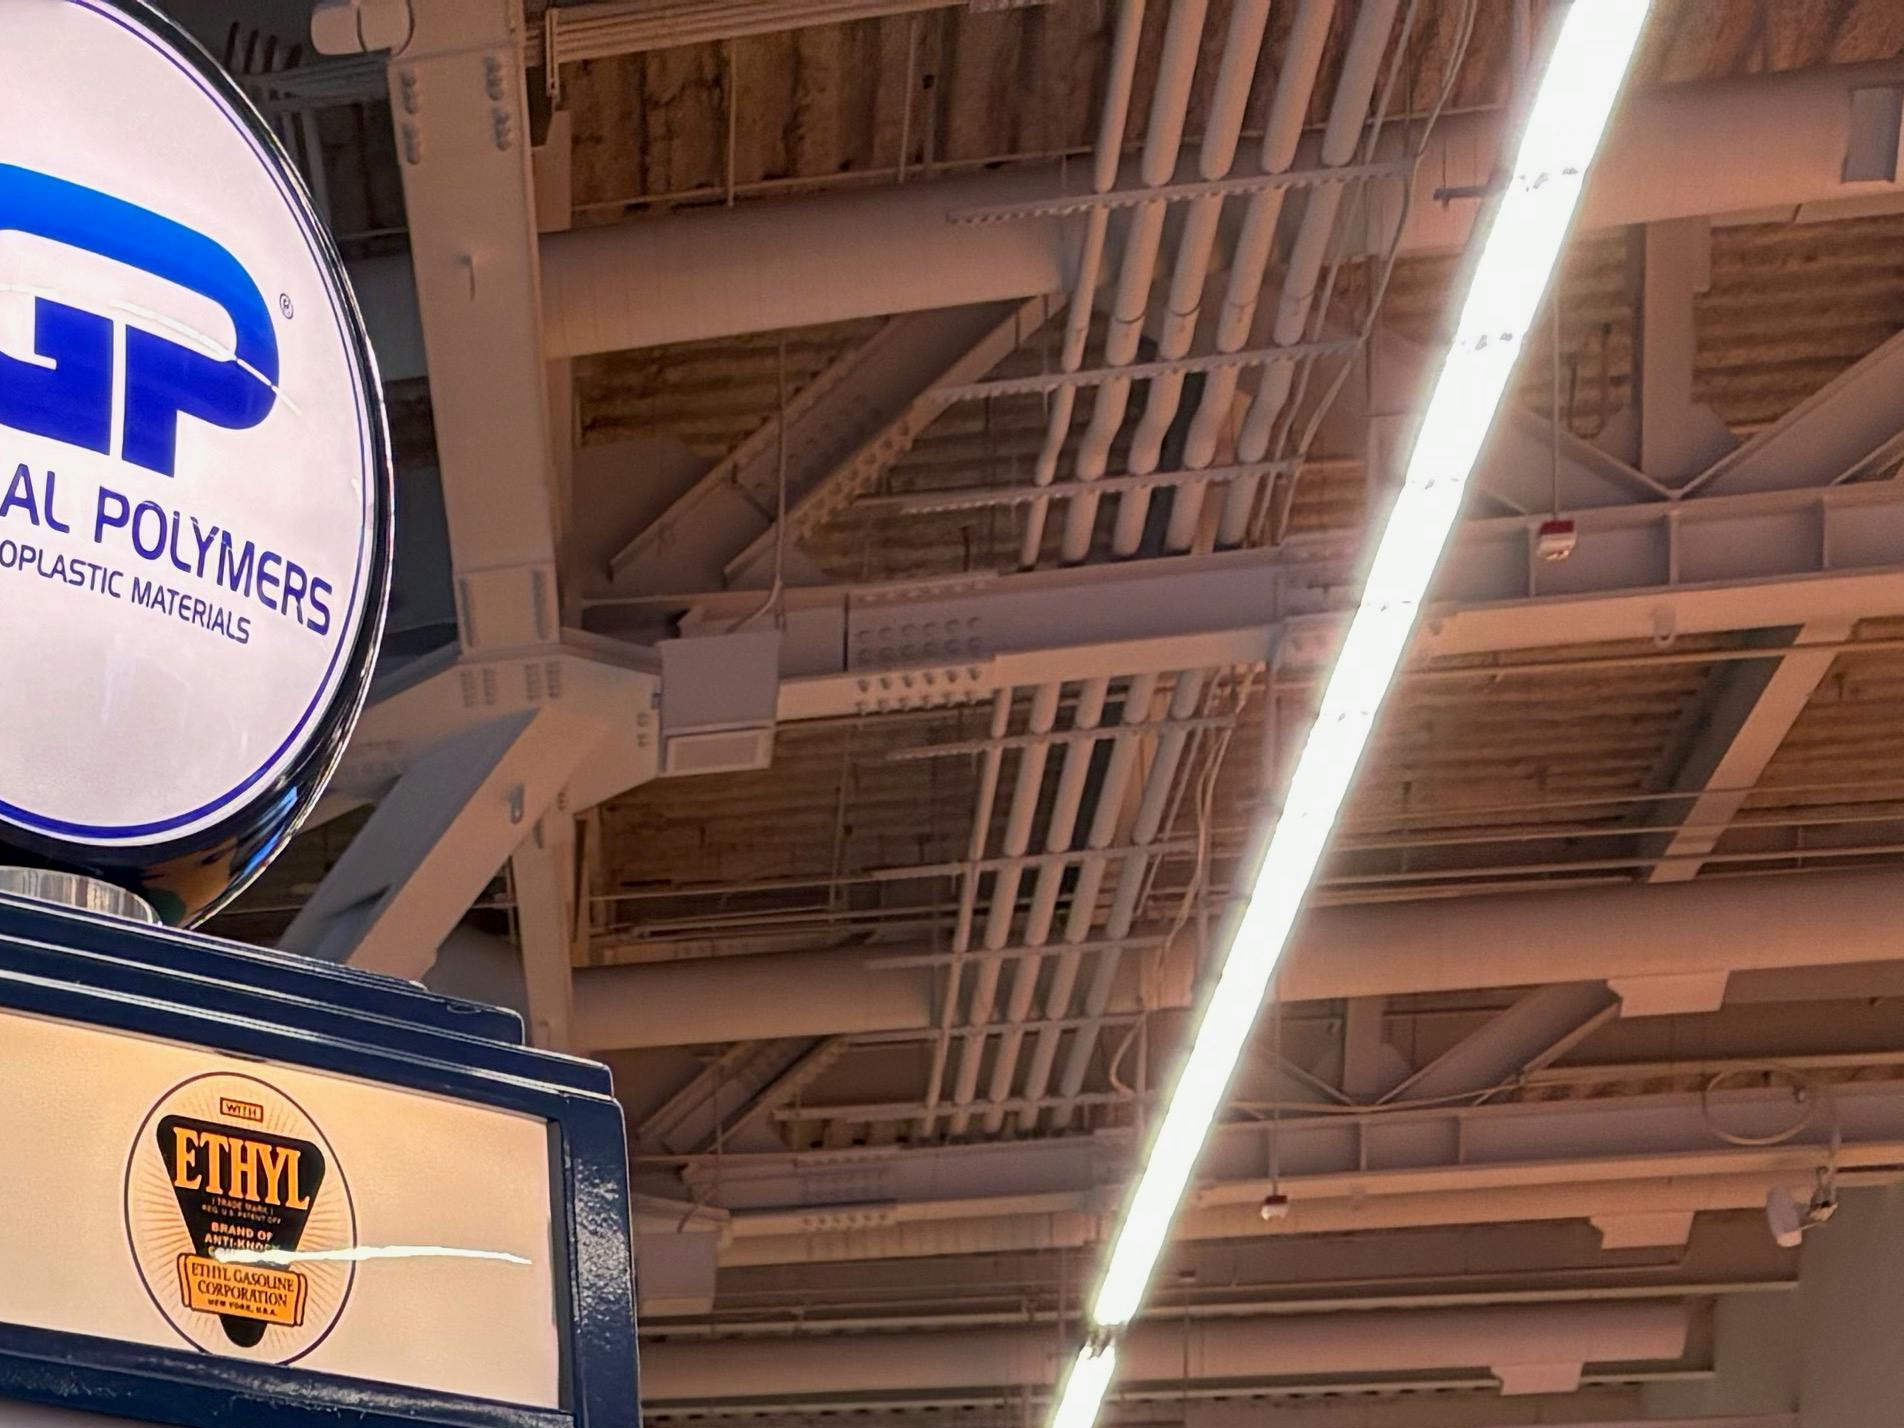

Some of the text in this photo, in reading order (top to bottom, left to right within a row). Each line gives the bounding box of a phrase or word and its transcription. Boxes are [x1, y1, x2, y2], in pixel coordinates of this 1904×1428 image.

[95, 486, 332, 637] POLYMERS
[132, 578, 250, 644] MATERIALS
[225, 1103, 257, 1118] WITH
[173, 1126, 310, 1210] ETHYL
[211, 1221, 273, 1242] BRAND OF
[192, 1261, 294, 1293] ETHYL GASOLINE
[197, 1280, 288, 1308] CORPORATION
